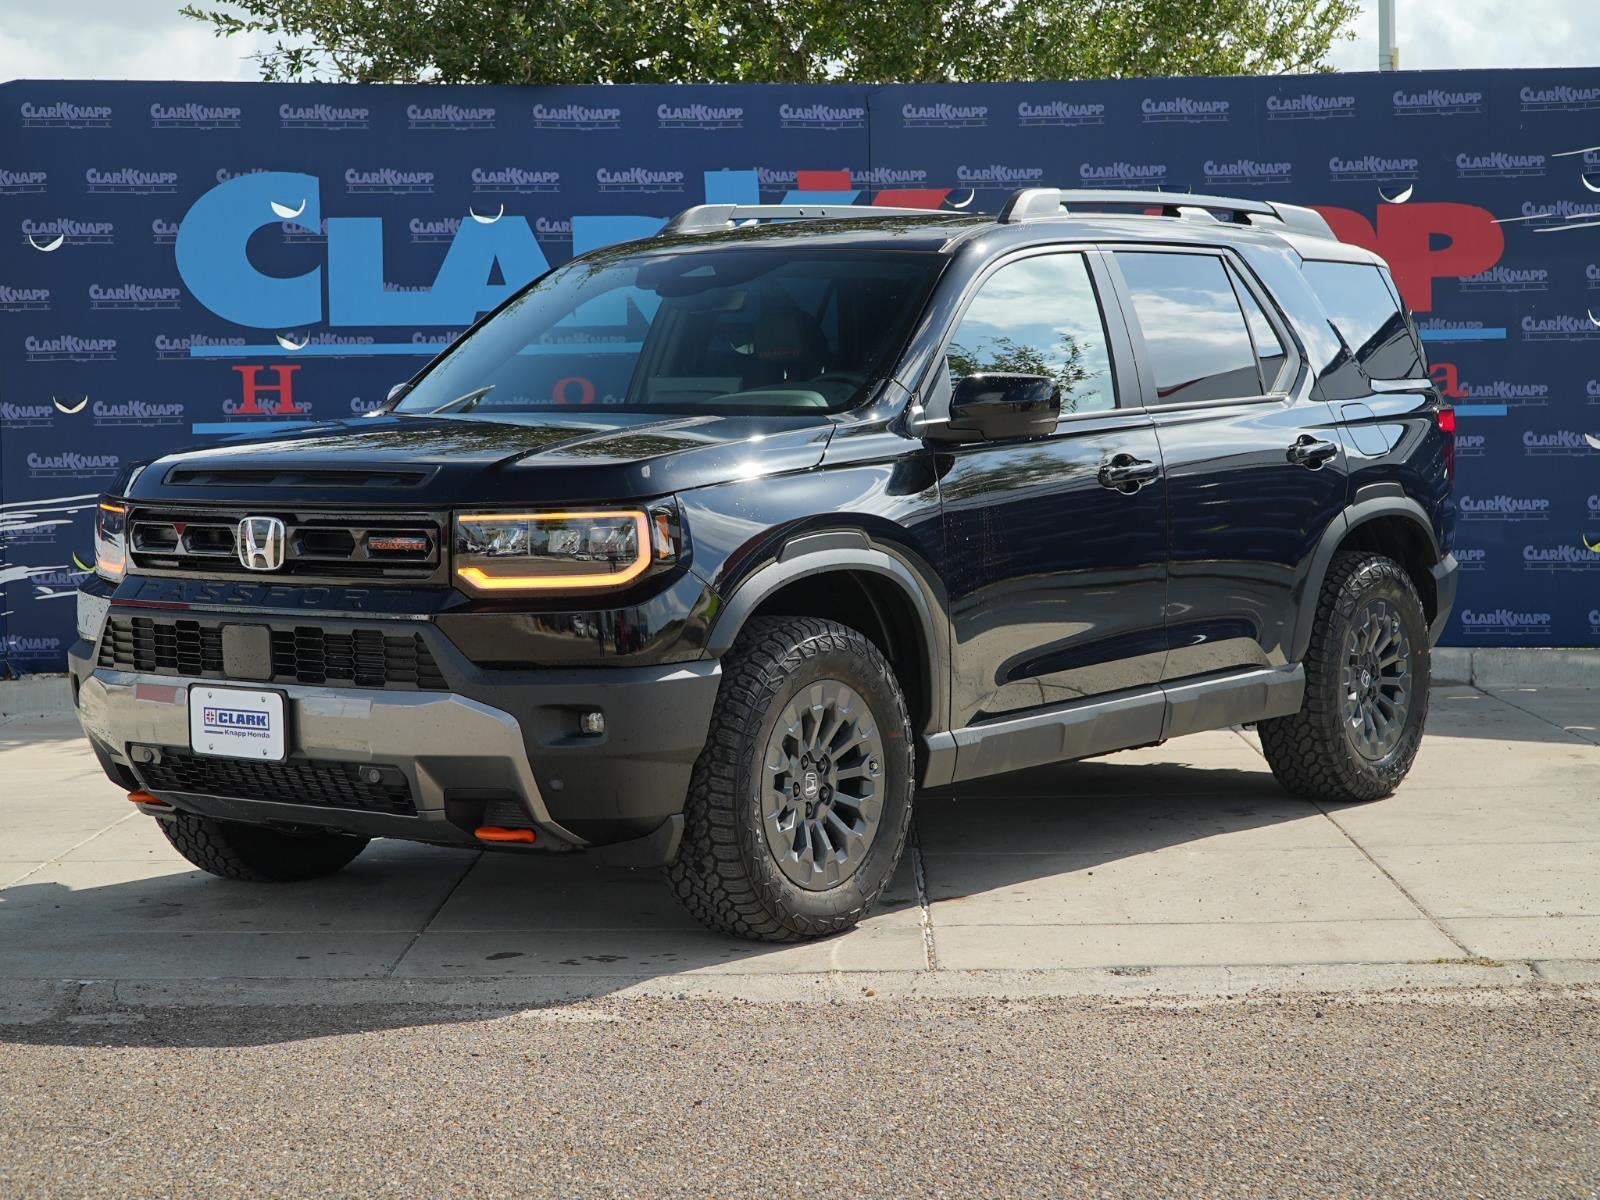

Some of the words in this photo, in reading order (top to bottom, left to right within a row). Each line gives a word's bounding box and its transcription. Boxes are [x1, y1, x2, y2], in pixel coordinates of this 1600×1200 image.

[218, 712, 267, 727] CLARK
[224, 729, 247, 738] Knapp
[247, 731, 270, 739] Honda
